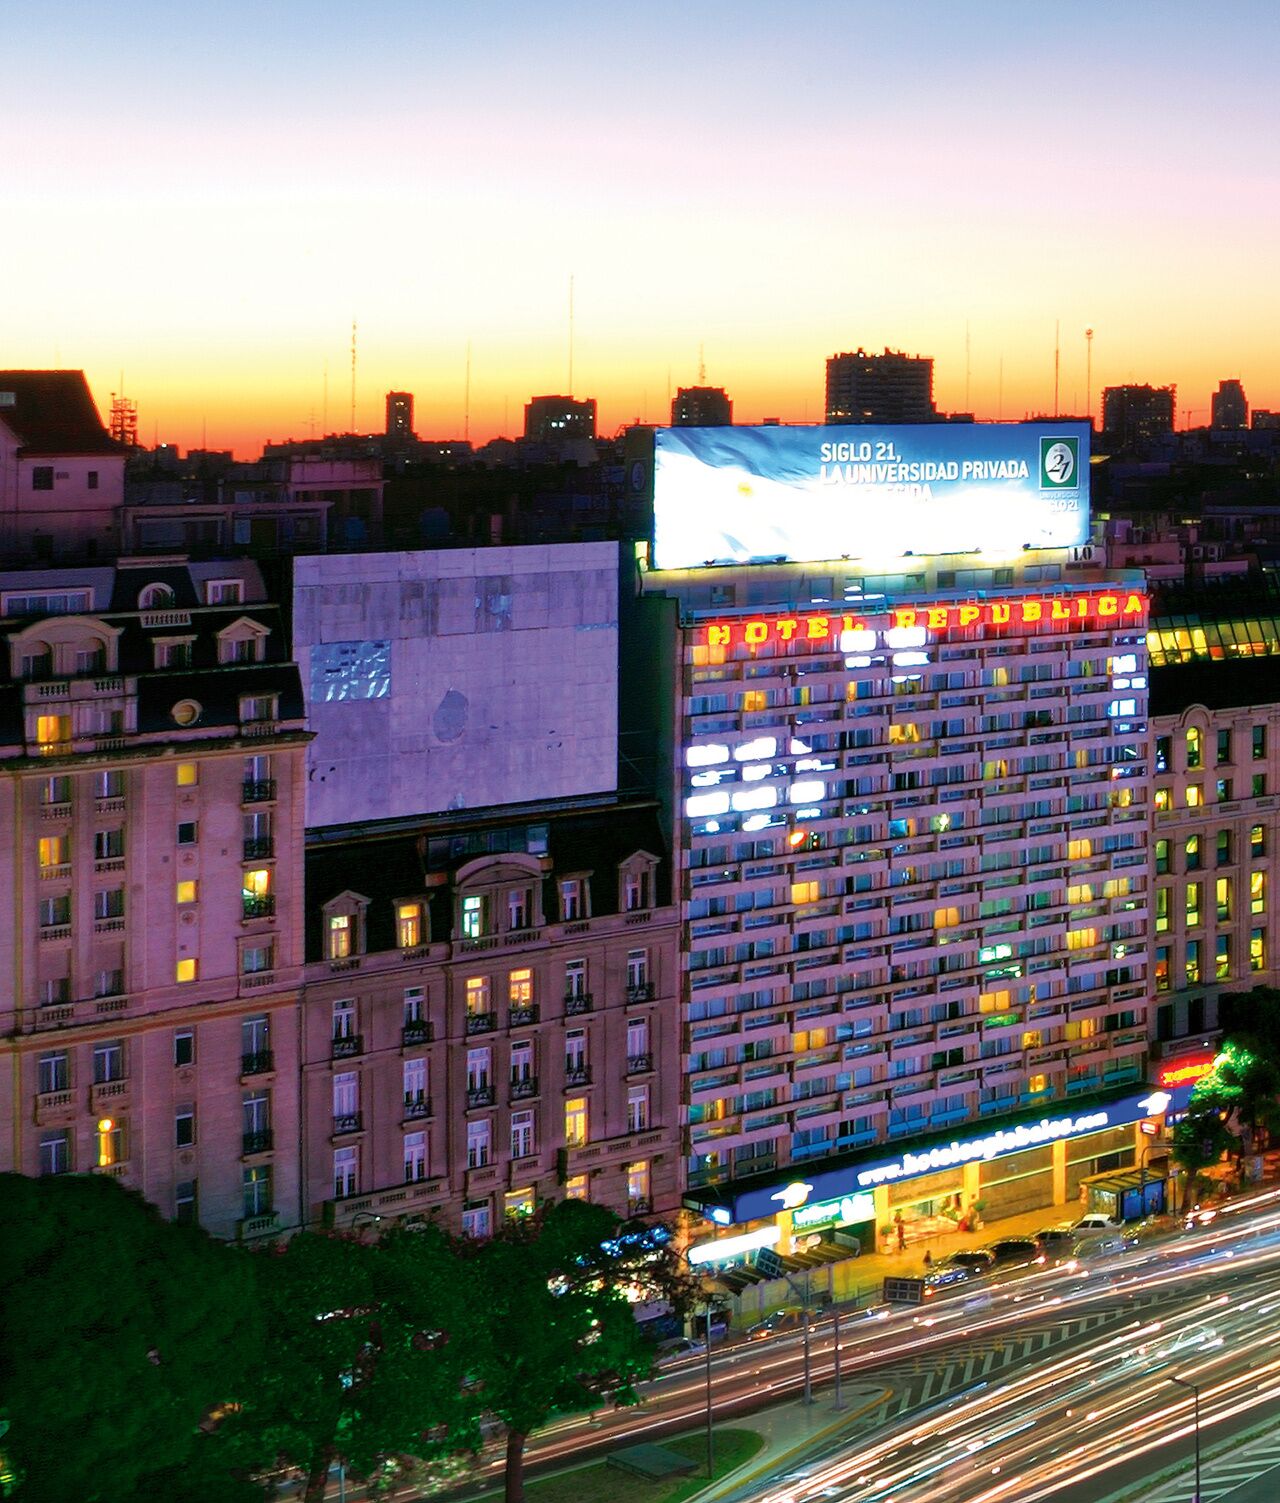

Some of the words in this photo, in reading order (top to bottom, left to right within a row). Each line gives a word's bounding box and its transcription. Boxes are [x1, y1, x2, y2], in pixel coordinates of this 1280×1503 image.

[820, 442, 872, 463] SIGLO
[876, 441, 902, 463] 21,
[820, 464, 844, 486] LA
[844, 461, 959, 484] UNIVERSIDAD
[962, 460, 1029, 480] PRIVADA
[1047, 453, 1071, 480] 21
[708, 616, 864, 645] HOTEL
[895, 595, 1143, 629] REPUBLICA
